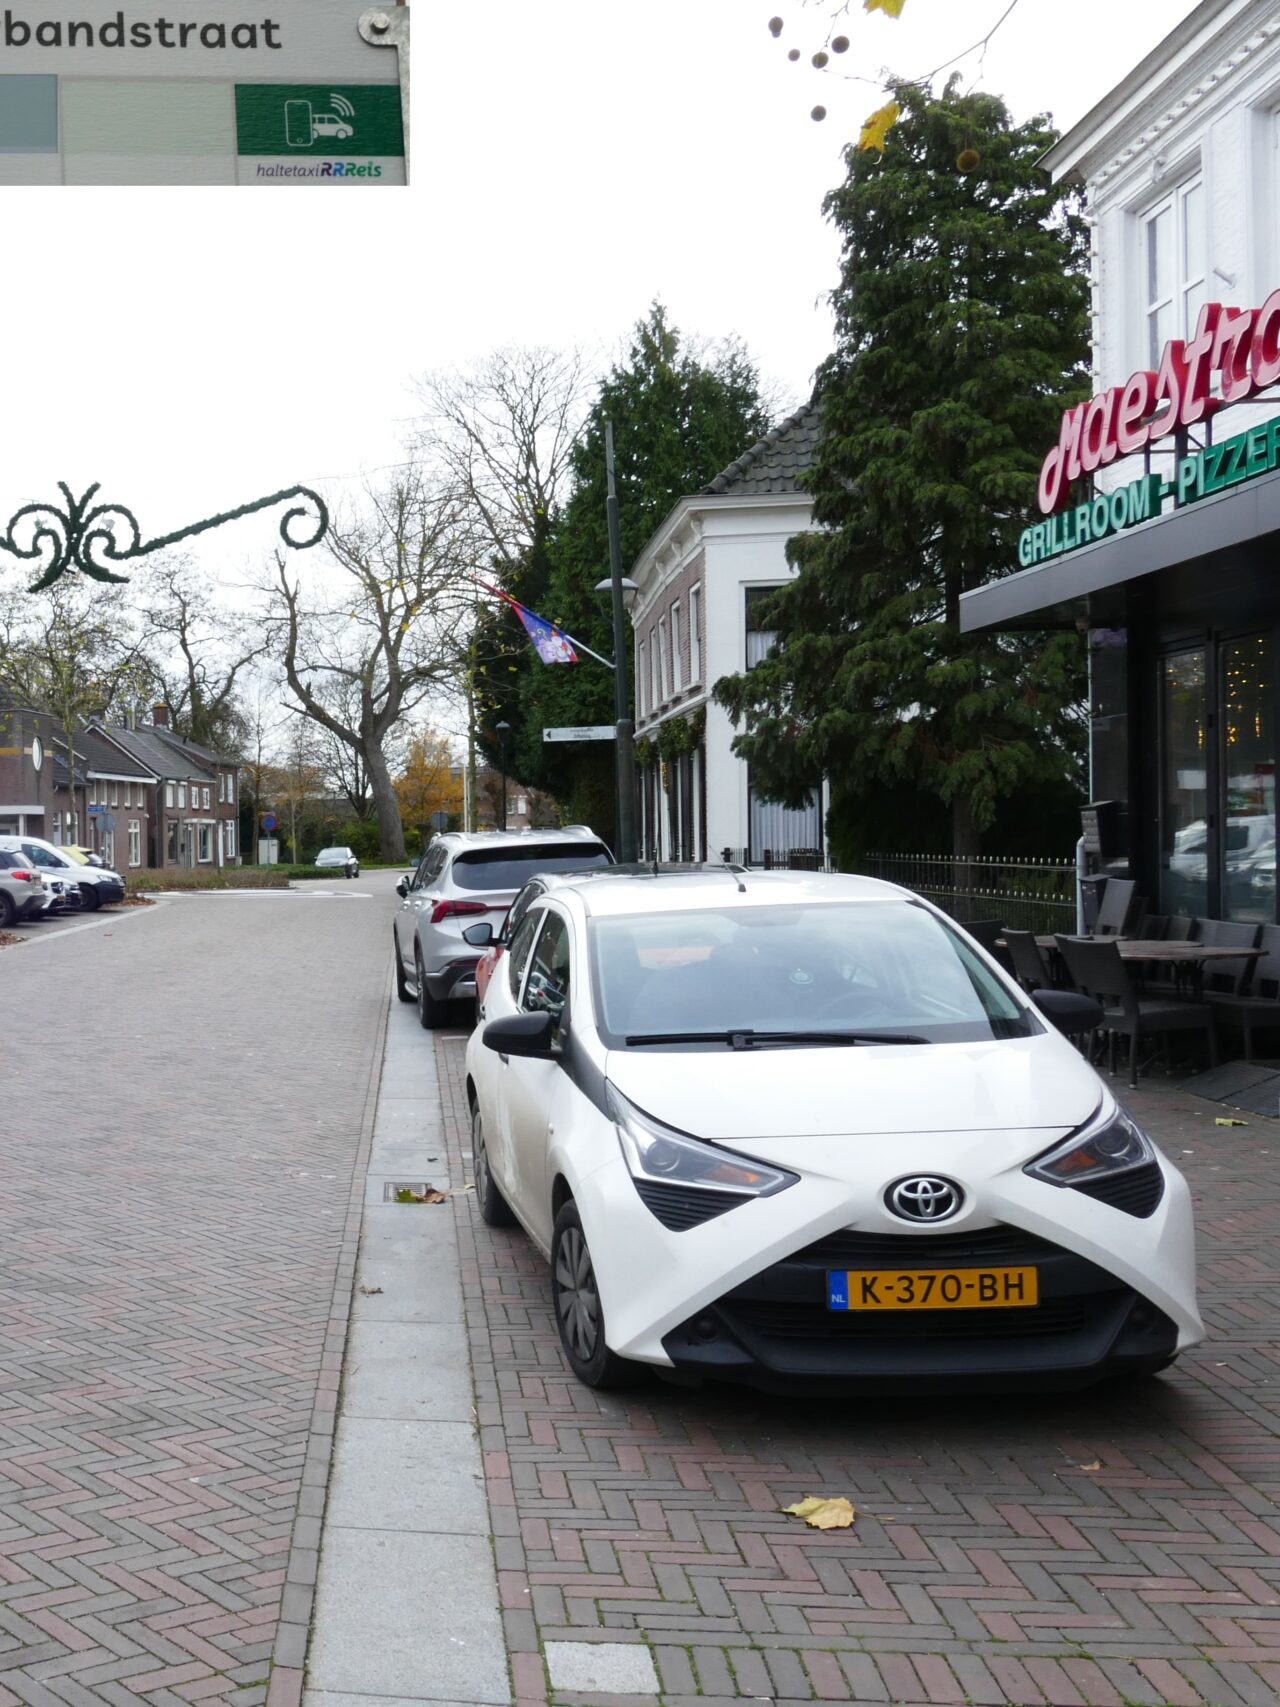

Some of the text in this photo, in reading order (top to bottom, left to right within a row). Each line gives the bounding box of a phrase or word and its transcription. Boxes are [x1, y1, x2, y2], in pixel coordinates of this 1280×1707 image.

[1018, 474, 1157, 567] GRILLROOM
[831, 1272, 1024, 1304] NL K-370-BH
